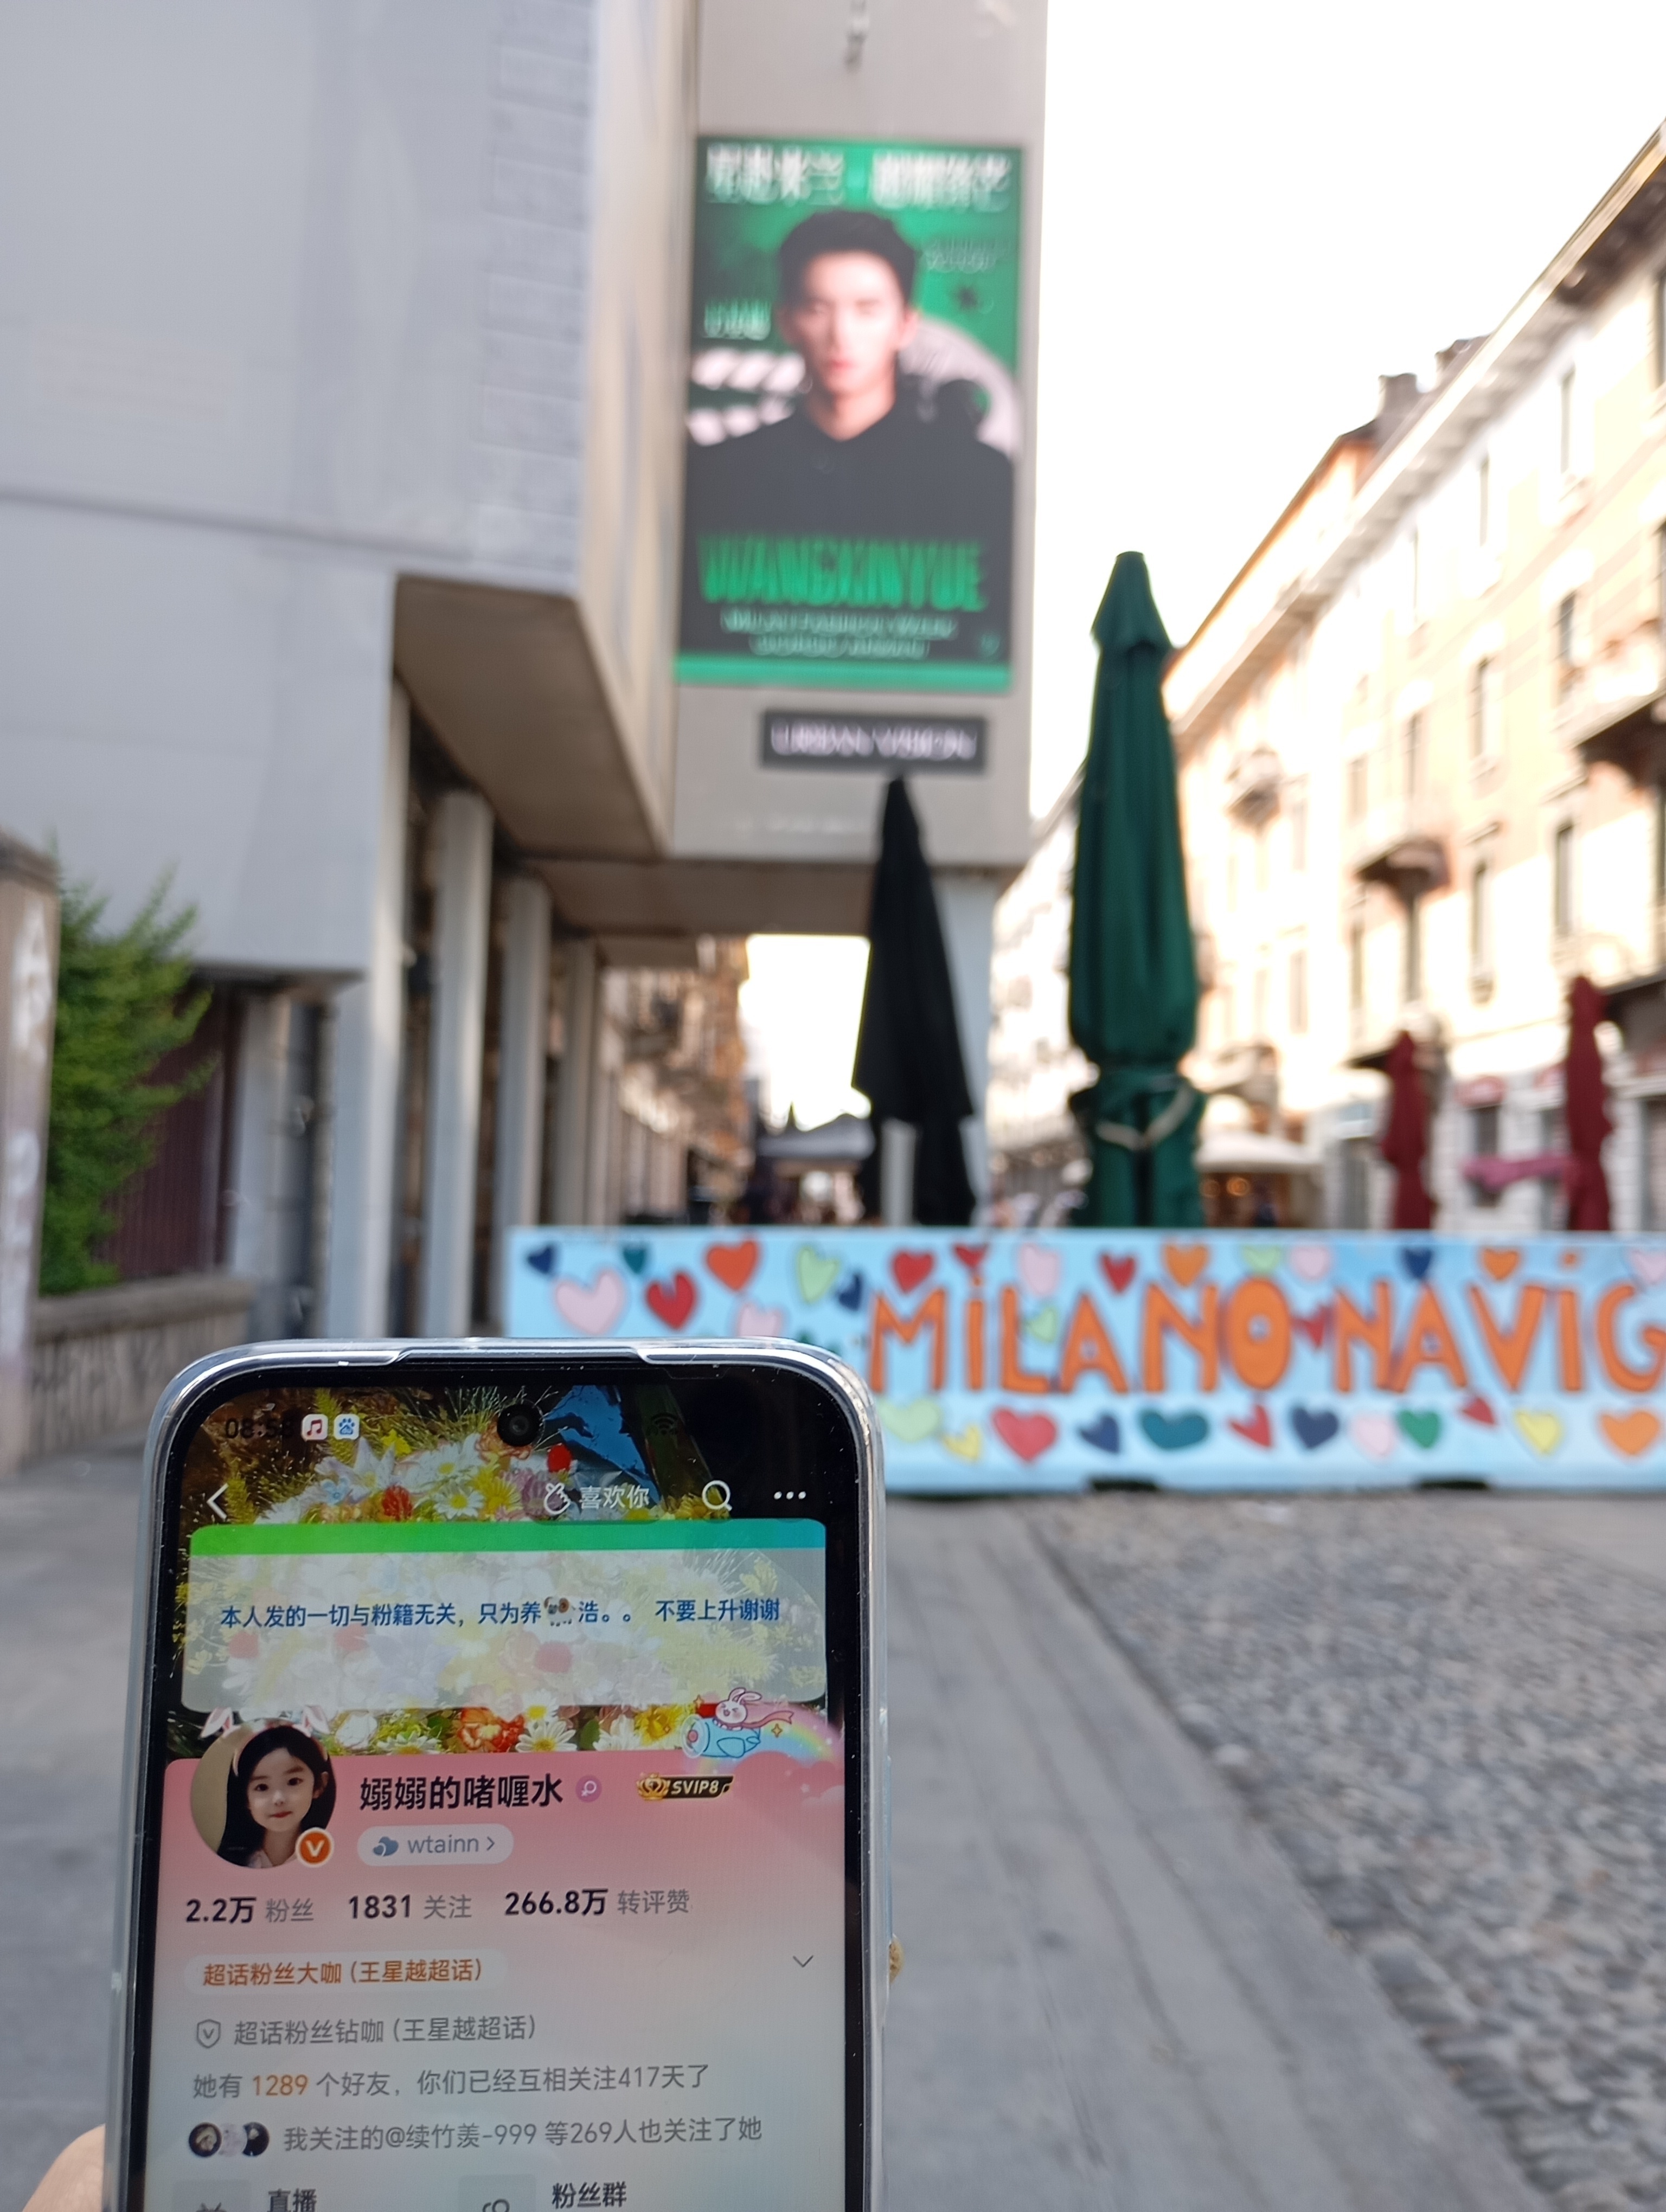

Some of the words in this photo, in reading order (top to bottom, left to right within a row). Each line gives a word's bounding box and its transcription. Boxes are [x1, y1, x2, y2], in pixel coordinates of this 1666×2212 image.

[579, 1485, 650, 1509] 喜欢你
[655, 1598, 780, 1622] 不要上升谢谢
[671, 1779, 720, 1795] SVIP8
[408, 1835, 479, 1854] wtainn
[185, 1896, 257, 1924] 2.2万
[265, 1898, 315, 1923] 粉丝
[349, 1895, 412, 1919] 1831
[423, 1894, 472, 1920] 关注
[504, 1888, 608, 1916] 266.8万
[617, 1888, 690, 1914] 转评赞
[203, 1963, 343, 1986] 超话粉丝大咖
[233, 2018, 385, 2046] 超话粉丝钻咖
[192, 2073, 243, 2099] 她有
[253, 2074, 309, 2096] 1289
[544, 2115, 762, 2147] 等269人也关注了她
[551, 2181, 627, 2209] 粉丝群
